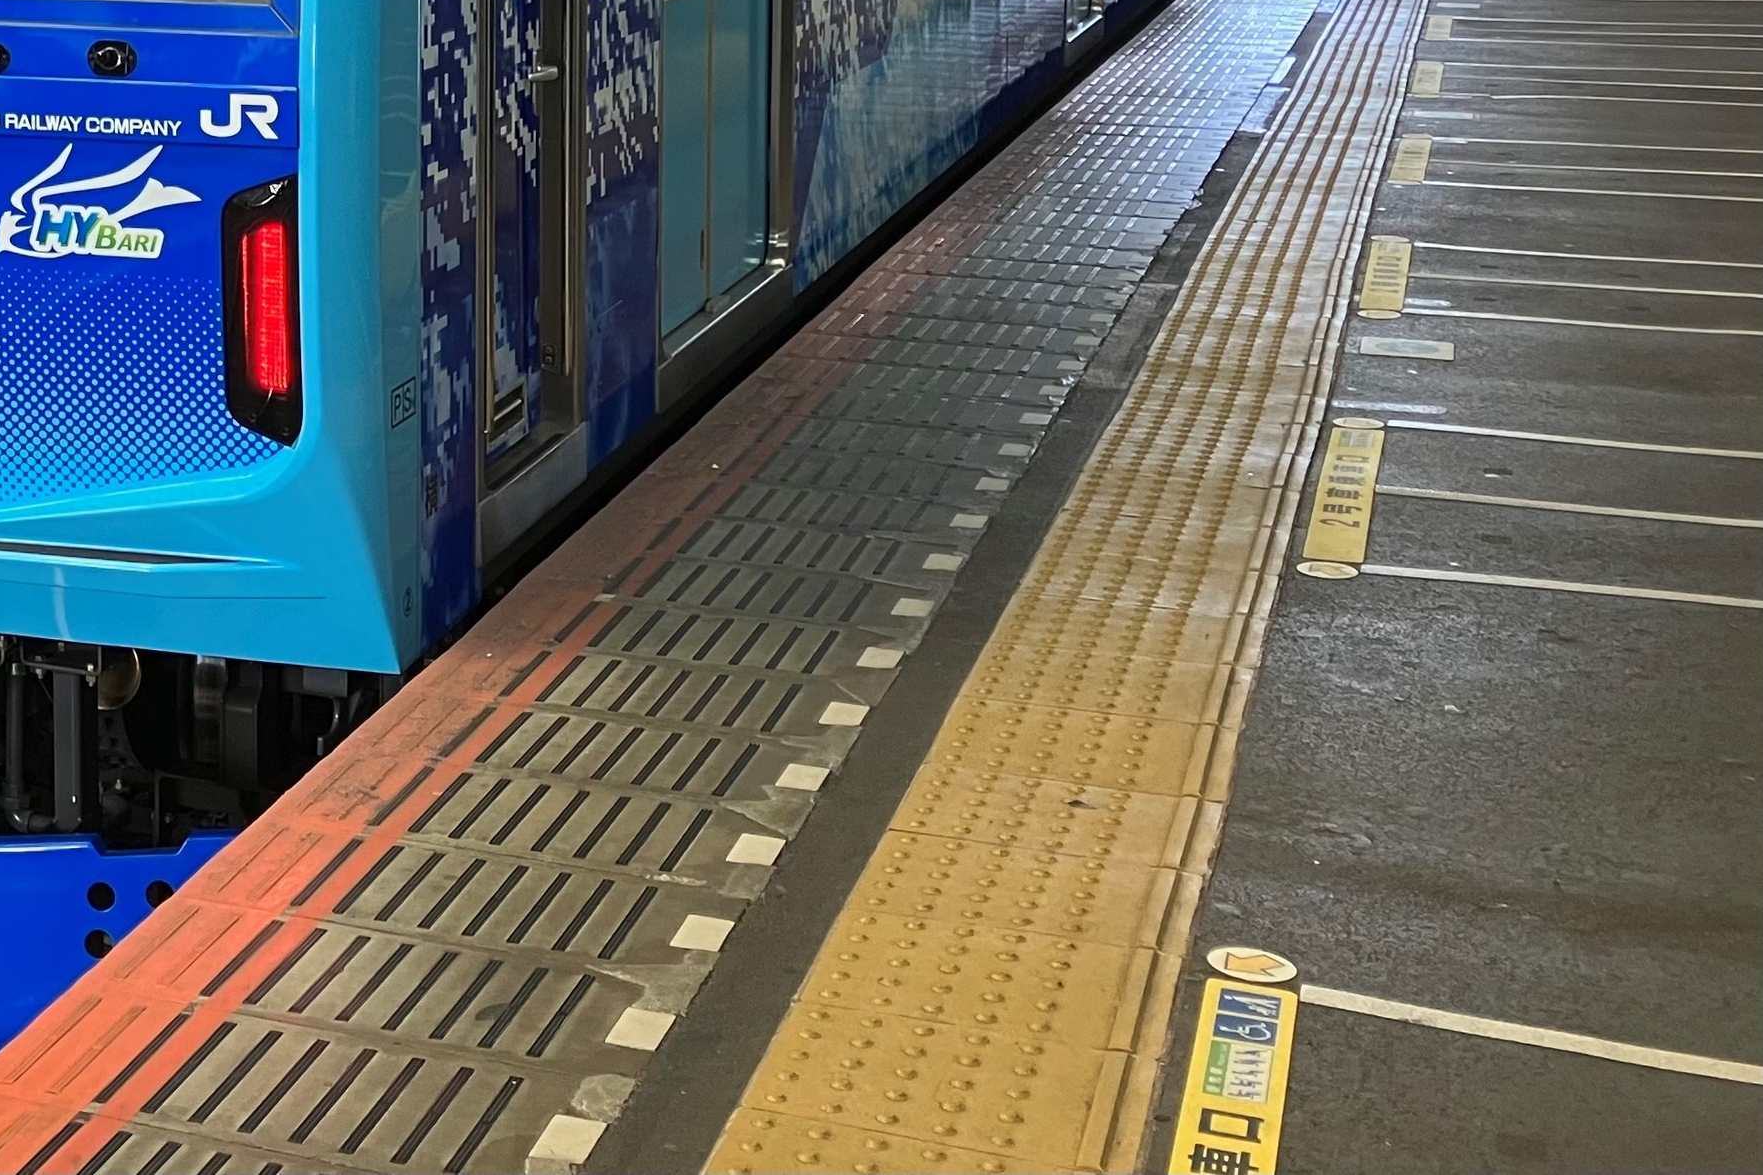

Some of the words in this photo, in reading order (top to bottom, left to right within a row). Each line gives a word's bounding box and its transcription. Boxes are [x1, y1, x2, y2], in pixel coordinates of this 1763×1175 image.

[4, 113, 83, 133] RAILWAY
[85, 116, 182, 137] COMPANY
[199, 93, 279, 140] JR
[35, 209, 159, 254] HYBARI
